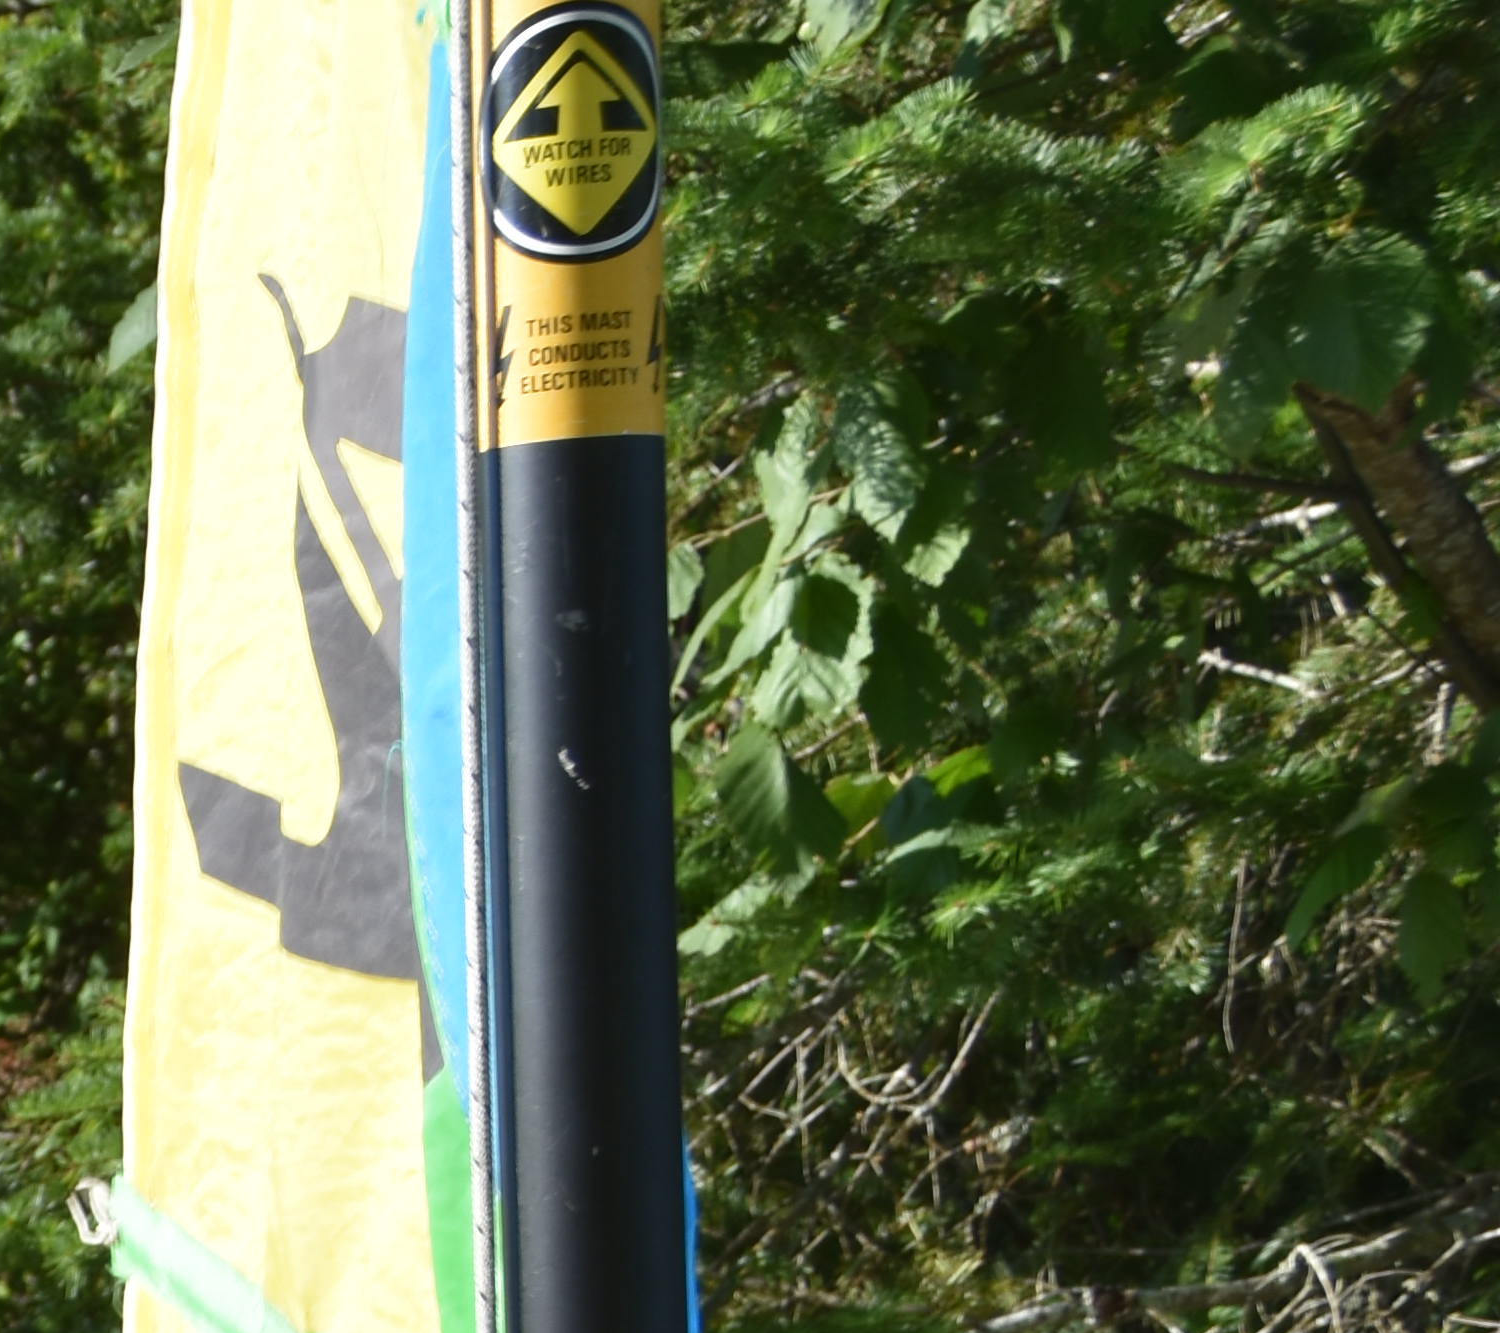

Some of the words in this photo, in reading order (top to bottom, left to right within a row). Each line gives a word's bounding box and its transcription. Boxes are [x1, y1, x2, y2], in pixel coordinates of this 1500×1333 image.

[524, 138, 592, 164] WATCH
[599, 137, 631, 157] FOR
[545, 163, 612, 187] WIRES
[526, 314, 573, 337] THIS
[580, 311, 632, 332] MAST
[528, 339, 631, 366] CONDUCTS
[521, 367, 639, 394] ELECTRICITY
